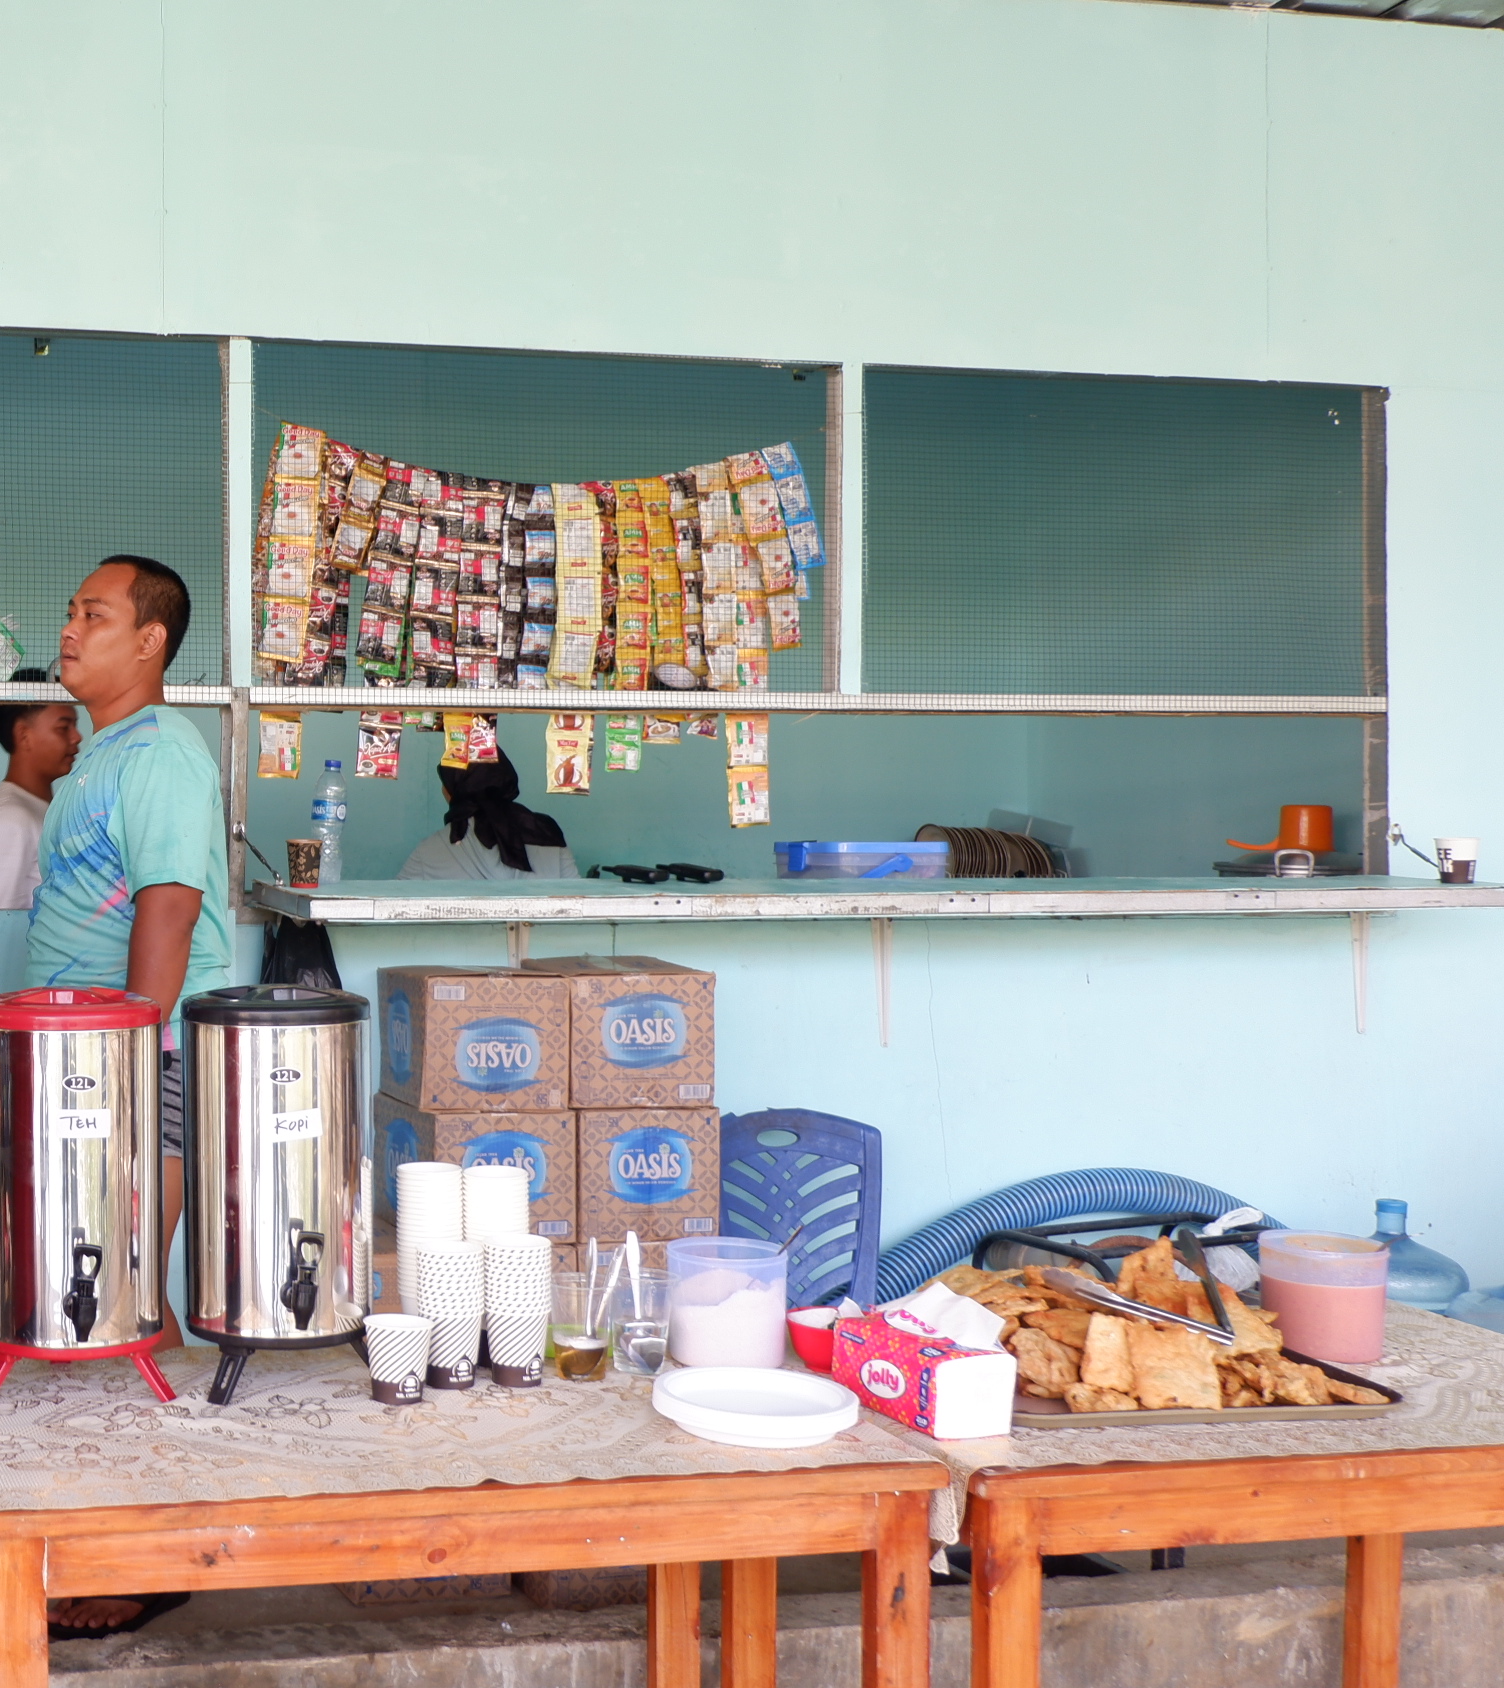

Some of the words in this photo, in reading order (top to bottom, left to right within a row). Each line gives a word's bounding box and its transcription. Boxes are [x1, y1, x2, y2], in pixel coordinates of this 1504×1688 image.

[297, 485, 313, 495] Day
[292, 547, 308, 557] Day
[264, 603, 285, 613] Good
[286, 606, 302, 617] Day
[364, 743, 381, 755] Kapal
[382, 743, 396, 754] Api
[610, 1018, 676, 1045] OASIS
[466, 1041, 532, 1068] OASIS
[276, 1070, 296, 1081] 12L
[70, 1078, 91, 1089] 12L
[59, 1116, 97, 1131] TEH
[618, 1153, 682, 1180] OASIS
[867, 1362, 899, 1393] jolly
